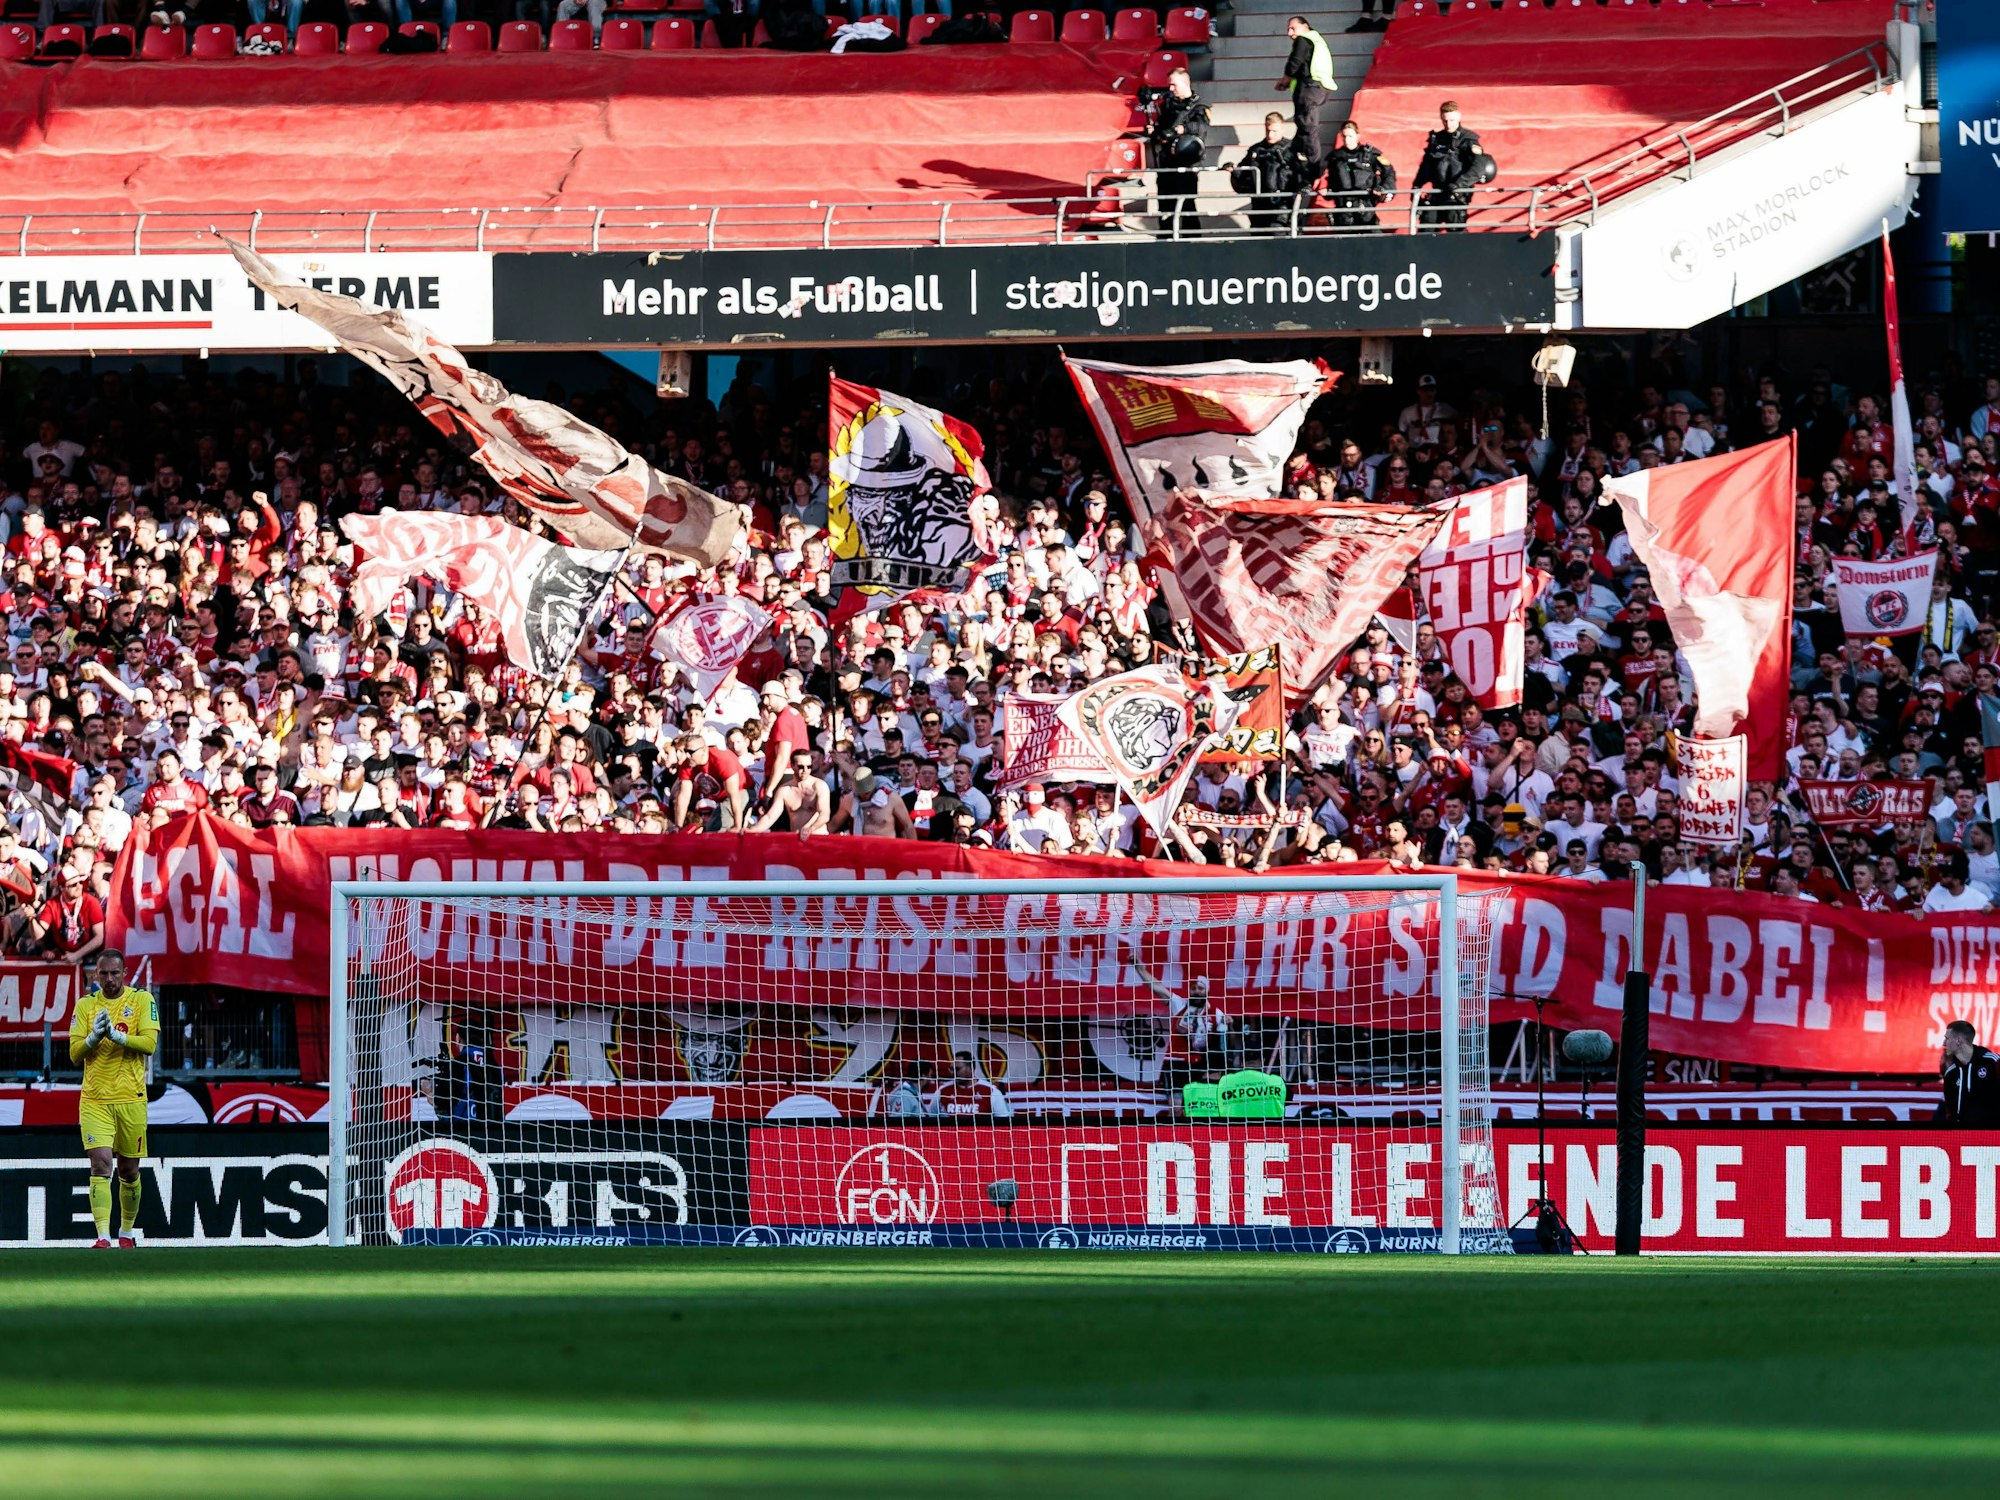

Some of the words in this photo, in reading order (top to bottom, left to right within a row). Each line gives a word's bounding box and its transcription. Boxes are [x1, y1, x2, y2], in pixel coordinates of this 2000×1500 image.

[1706, 210, 1751, 241] MAX
[1755, 162, 1850, 217] MORLOCK
[1712, 208, 1797, 259] STADION
[0, 278, 213, 314] ELMANN
[603, 278, 708, 316] Mehr
[717, 277, 778, 315] als
[789, 274, 943, 316] Fußball
[1005, 262, 1443, 312] stadion-nuernberg.de
[1838, 564, 1930, 585] Domsturm
[1007, 706, 1031, 718] DIE
[1008, 713, 1059, 734] EINER
[1008, 729, 1052, 751] WIRD
[1313, 744, 1341, 753] REWE
[1007, 741, 1052, 769] ZAHL
[1007, 759, 1046, 780] FEINDE
[1697, 783, 1710, 800] 6
[125, 843, 296, 960] EGAL
[331, 854, 586, 965] WOHIN
[603, 863, 730, 968] DIE
[764, 864, 979, 979] REISE
[1003, 889, 1201, 990] GEHT
[1226, 890, 1351, 993] IHR
[1593, 908, 1835, 1032] DABEI
[1863, 938, 1886, 1033] !
[1239, 1086, 1281, 1098] POWER
[947, 1103, 979, 1113] REWE
[137, 1136, 143, 1153] 1
[1147, 1142, 1290, 1227] DIE
[1331, 1143, 1745, 1238] LEGENDE
[1785, 1145, 2000, 1239] LEBT
[847, 1187, 927, 1224] FCN
[510, 1236, 627, 1247] NÜRNBERGER
[790, 1230, 933, 1246] NÜRNBERGER
[1087, 1233, 1207, 1248] NÜRNBERGER
